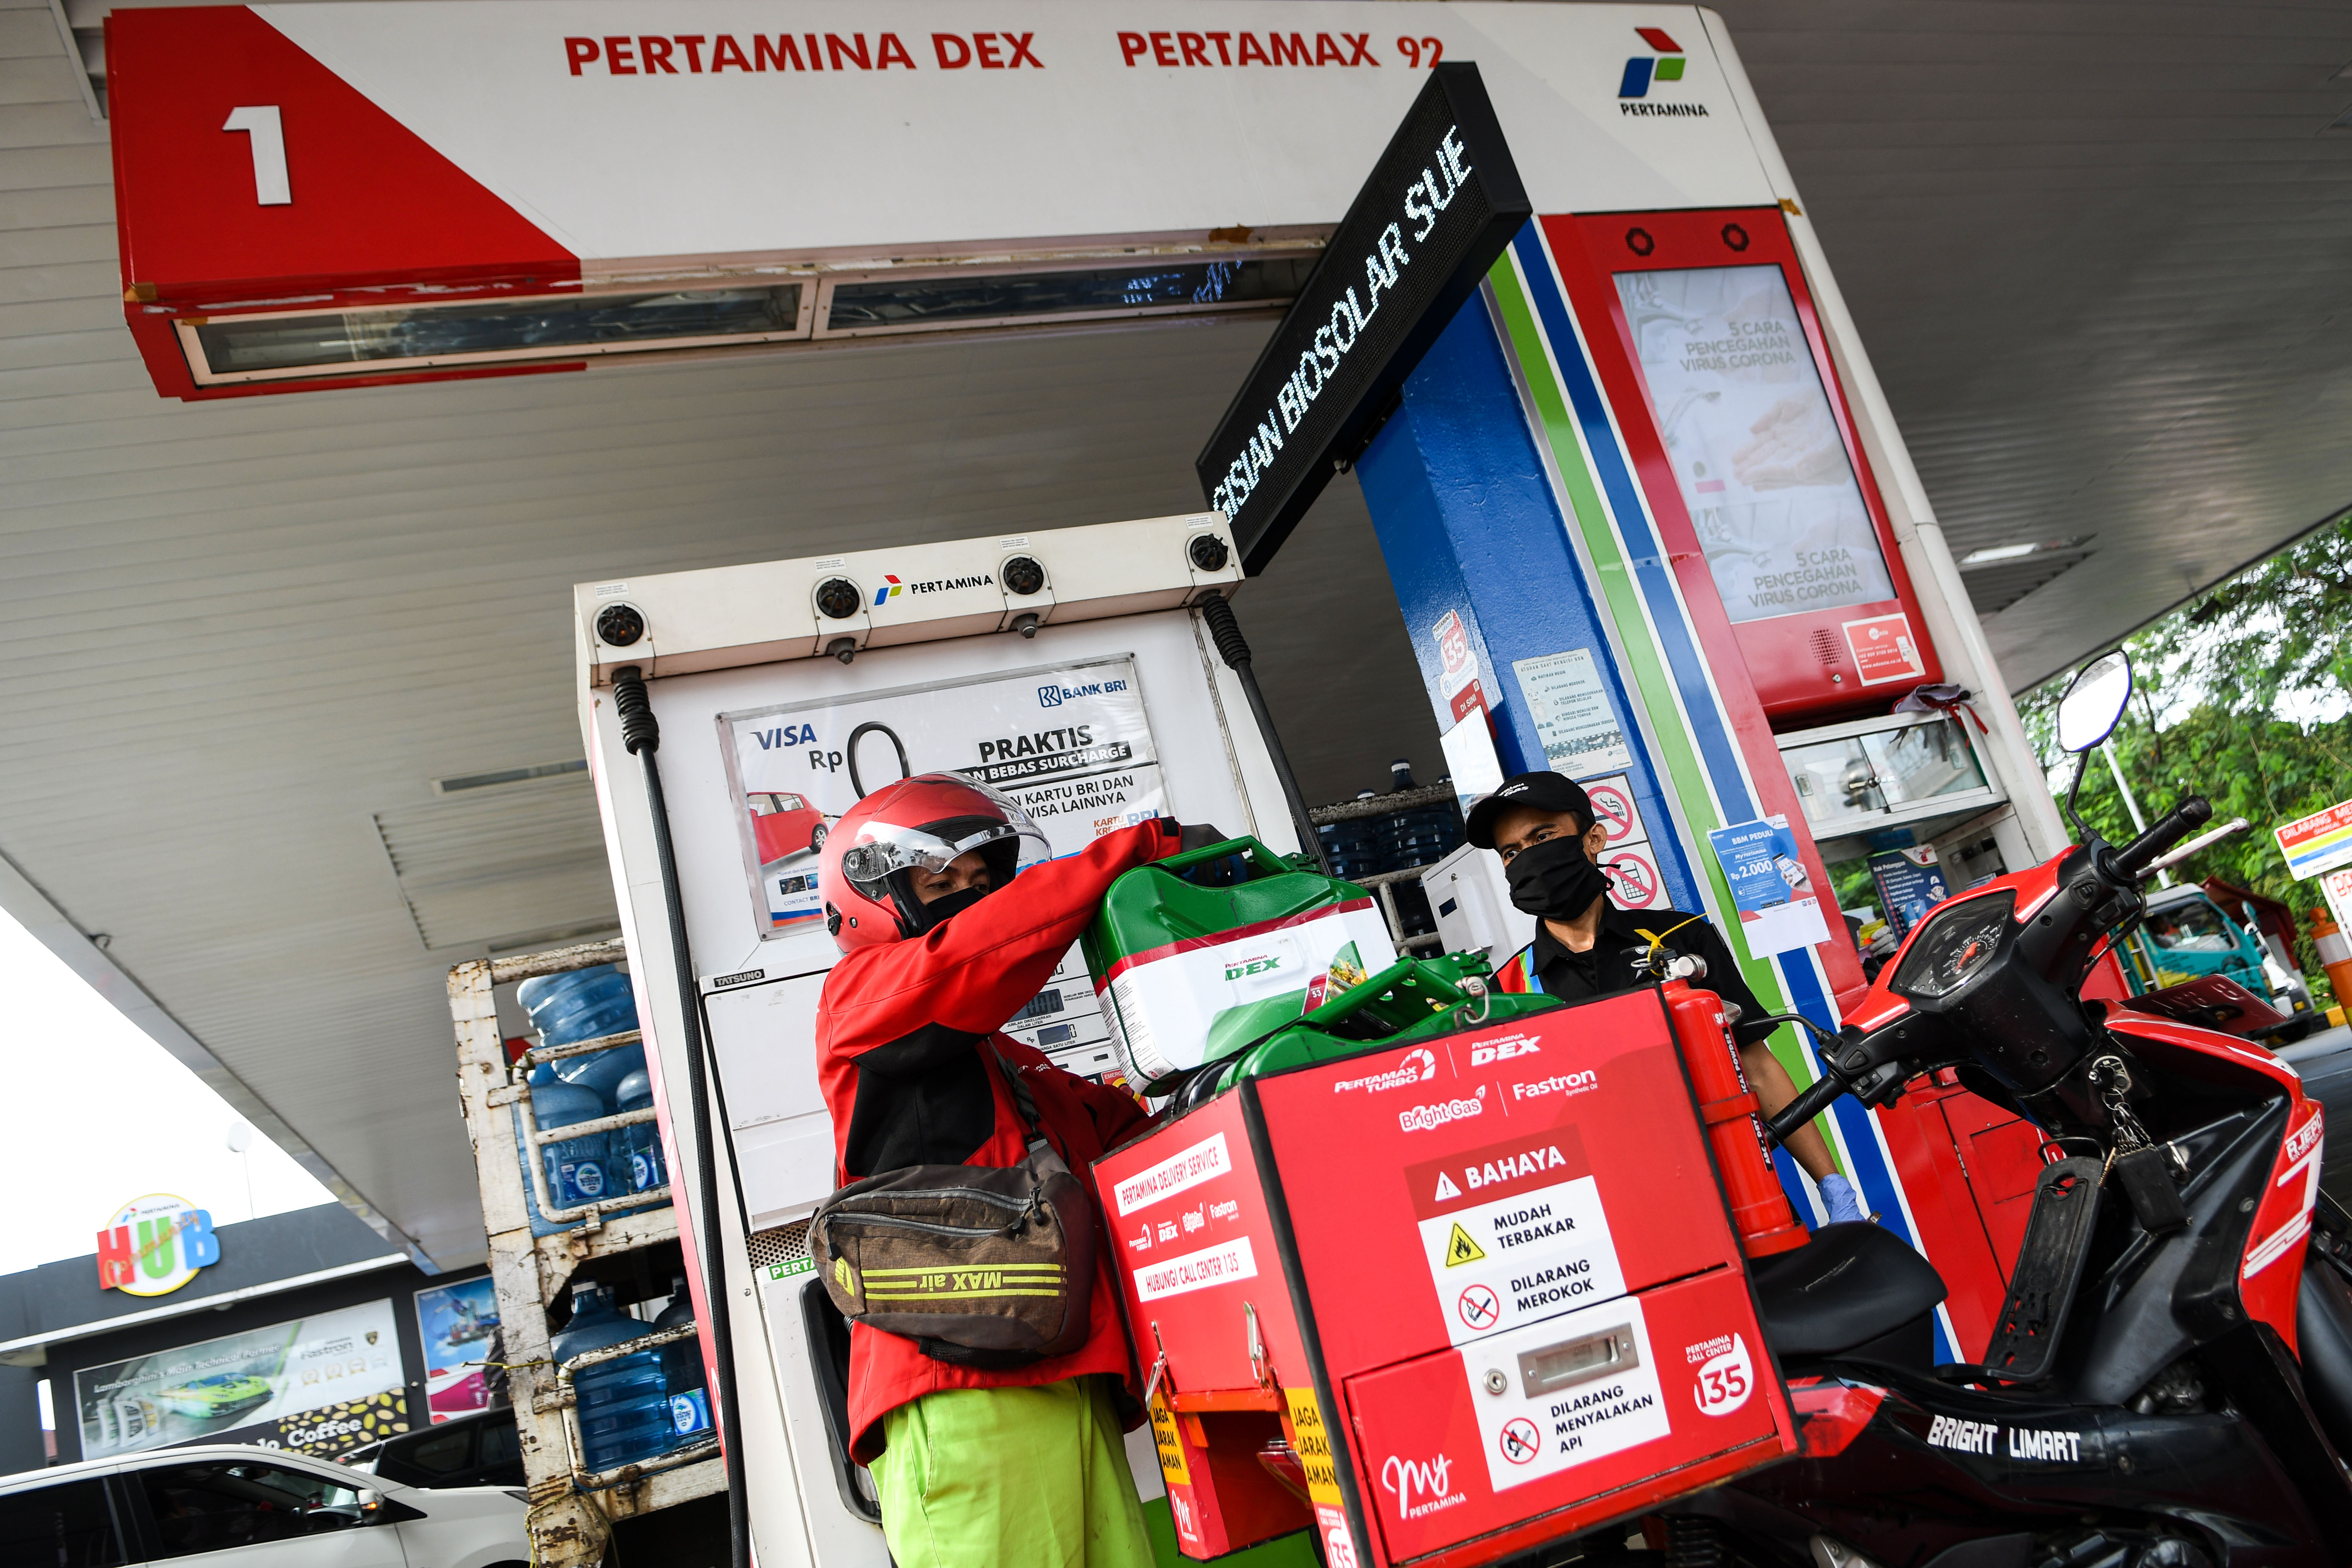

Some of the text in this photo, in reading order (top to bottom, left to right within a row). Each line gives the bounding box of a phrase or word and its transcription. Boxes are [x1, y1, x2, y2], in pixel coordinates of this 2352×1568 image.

[564, 31, 1045, 76] PERTAMINA DEX
[1117, 31, 1443, 68] PERTAMAX 92
[1620, 103, 1709, 117] PERTAMINA
[222, 105, 292, 206] 1
[1278, 223, 1409, 434] BIOSOLAR
[1729, 321, 1785, 336] 5 CARA
[1685, 336, 1790, 357] PENCEGAHAN
[1680, 352, 1796, 373] VIRUS CORONA
[1796, 548, 1851, 567] 5 CARA
[911, 575, 994, 593] PERTAMINA
[1754, 564, 1857, 590] PENCEGAHAN
[1748, 581, 1862, 608] VIRUS CORONA
[1442, 634, 1465, 670] 135
[1062, 680, 1127, 700] BANK BRI
[1577, 689, 1603, 697] MENGGUNAKAN
[1460, 703, 1467, 713] DI
[1467, 694, 1477, 708] SINI
[750, 723, 817, 750] VISA
[1576, 722, 1600, 731] MENGGUNAKAN
[978, 725, 1093, 763] PRAKTIS
[809, 750, 843, 773] Rp
[989, 746, 1127, 779] BEBAS SURCHARGE
[1025, 786, 1072, 805] KARTU
[1076, 781, 1100, 794] BRI
[1103, 775, 1134, 791] DAN
[1026, 792, 1126, 819] VISA LAINNYA
[1094, 815, 1124, 828] KARTU
[2282, 813, 2332, 840] DILARANG
[1731, 835, 1749, 845] BBM
[1749, 829, 1773, 841] PEDULI
[1730, 860, 1773, 881] Rp 2.000
[784, 897, 808, 906] CONTACT
[1225, 955, 1268, 968] PERTAMINA
[1225, 957, 1281, 981] DEX
[715, 971, 762, 987] TATSUNO
[1024, 1015, 1051, 1023] DIKELUARKAN
[1471, 1036, 1541, 1066] DEX
[1472, 1033, 1524, 1049] PERTAMINA
[1334, 1067, 1417, 1092] PERTAMAX
[1367, 1075, 1418, 1093] TURBO
[1513, 1070, 1596, 1100] Fastron
[1565, 1085, 1589, 1097] Synthetic
[1725, 1033, 1771, 1165] ABC DRY POWDER
[1402, 1100, 1480, 1129] Bright Gas
[1122, 1146, 1219, 1206] PERTAMINA DELIVERY SERVICE
[1465, 1146, 1566, 1189] BAHAYA
[1210, 1200, 1237, 1219] Fastron
[1494, 1203, 1552, 1230] MUDAH
[1129, 1236, 1147, 1247] PERTAMAX
[1159, 1225, 1178, 1242] DEX
[1497, 1217, 1576, 1249] TERBAKAR
[97, 1209, 220, 1290] HUB
[1136, 1242, 1148, 1251] TURBO
[919, 1272, 1001, 1292] MAX air
[1146, 1252, 1239, 1293] HUBUNGI CALL CENTER 135
[1511, 1259, 1590, 1292] DILARANG
[1517, 1278, 1595, 1312] MEROKOK
[301, 1342, 353, 1359] Fastron
[1685, 1334, 1731, 1355] PERTAMINA
[1686, 1342, 1732, 1363] CALL CENTER
[94, 1371, 165, 1394] Lamborghini's
[167, 1365, 193, 1377] Main
[196, 1353, 240, 1368] Technical
[1696, 1364, 1746, 1408] 135
[1551, 1386, 1624, 1418] DILARANG
[1153, 1407, 1169, 1424] JAGA
[1293, 1407, 1320, 1427] JAGA
[1556, 1394, 1653, 1435] MENYALAKAN
[287, 1418, 362, 1446] Coffee
[1156, 1430, 1176, 1447] JARAK
[1927, 1414, 2080, 1462] BRIGHT LIMART
[1298, 1437, 1331, 1456] JARAK
[1560, 1436, 1582, 1454] API
[1162, 1453, 1181, 1470] AMAN
[1307, 1466, 1338, 1486] AMAN
[1410, 1492, 1467, 1519] PERTAMINA
